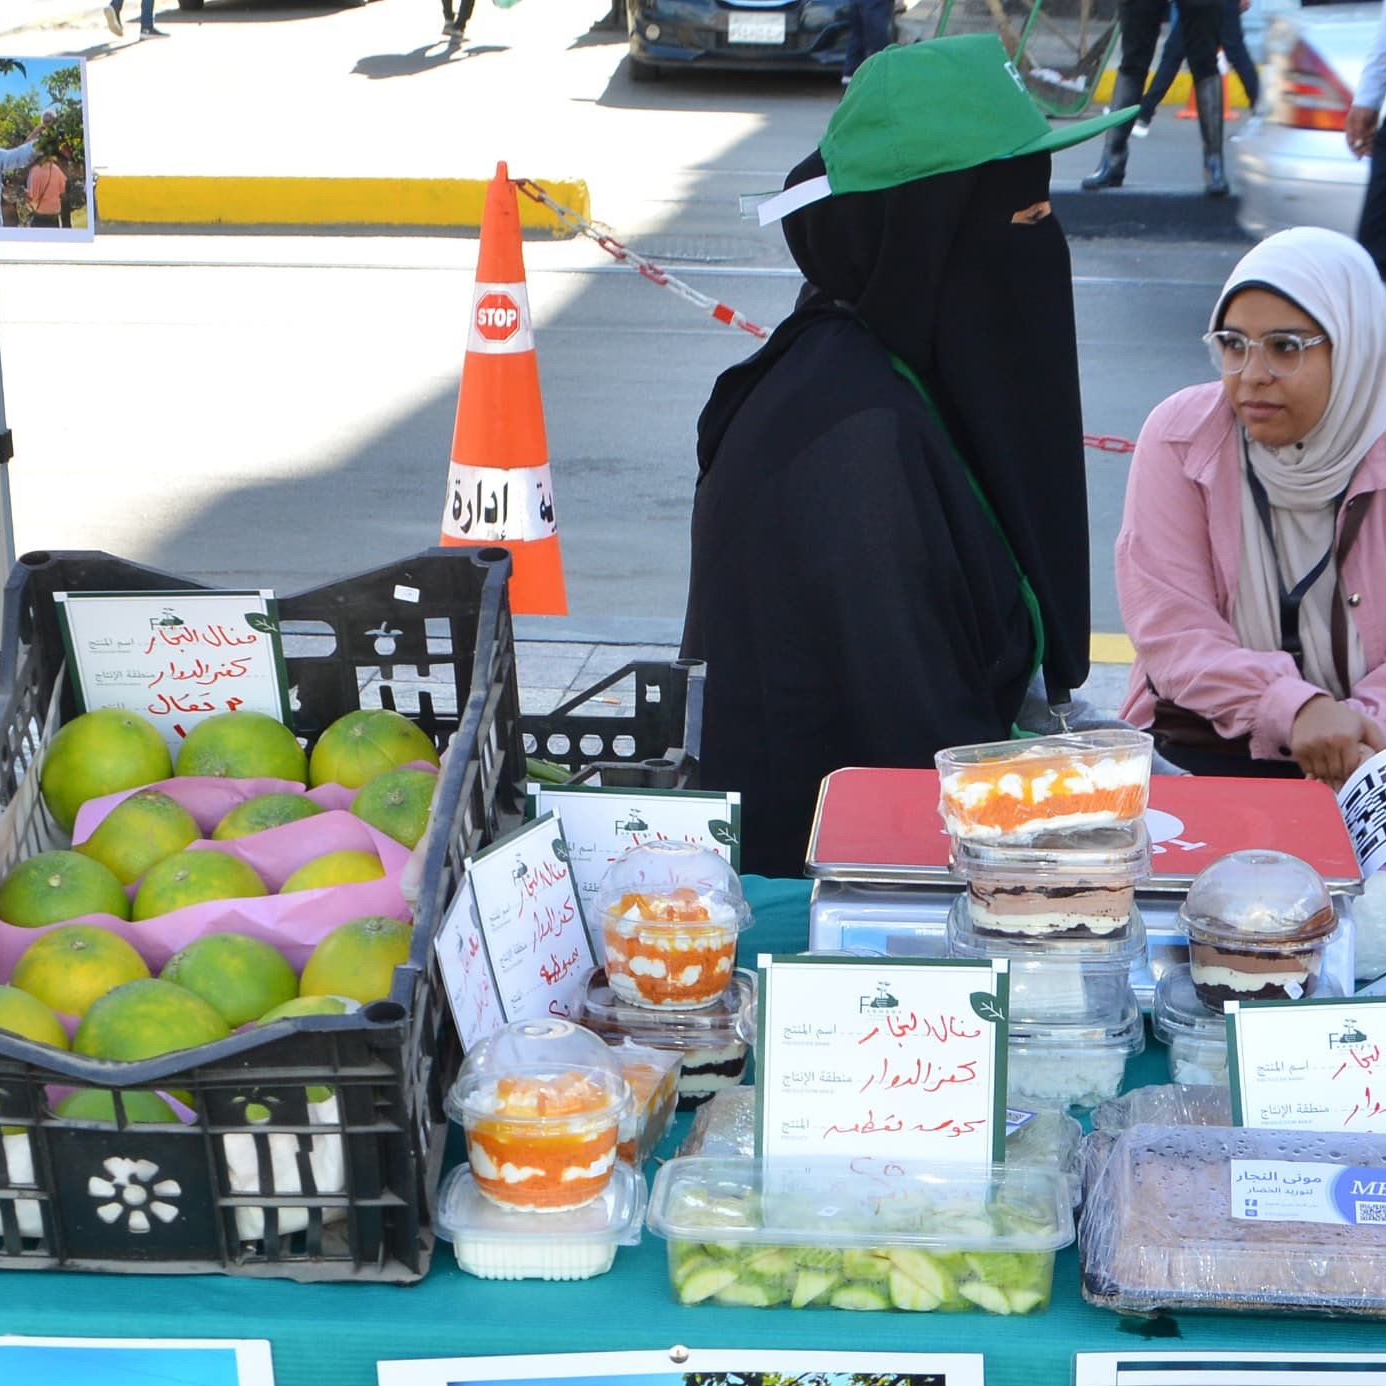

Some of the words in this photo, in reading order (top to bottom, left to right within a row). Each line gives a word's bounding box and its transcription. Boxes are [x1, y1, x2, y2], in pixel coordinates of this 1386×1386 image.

[477, 307, 517, 328] STOP
[452, 479, 509, 541] إدارة
[783, 1023, 812, 1040] المنتج
[815, 1024, 837, 1039] اسم
[1256, 1061, 1285, 1077] المنتج
[1288, 1060, 1309, 1075] اسم
[819, 1070, 853, 1085] منطقة
[1296, 1103, 1330, 1114] منطقة
[781, 1119, 810, 1134] المنتج
